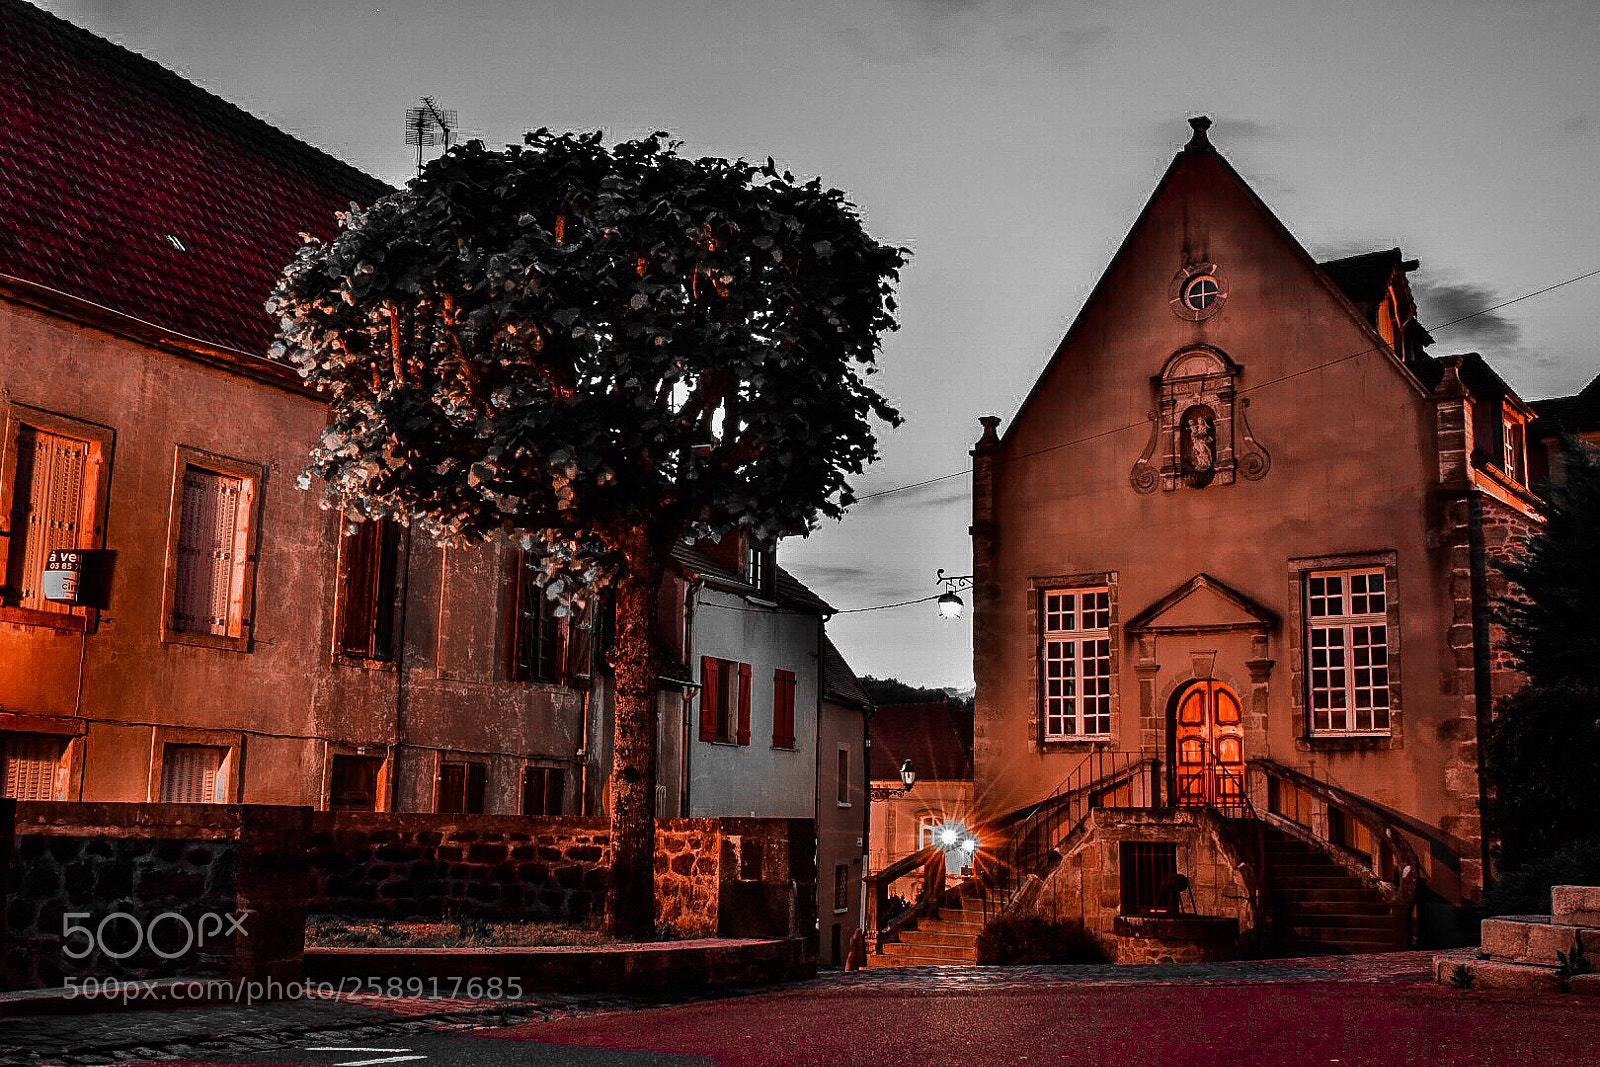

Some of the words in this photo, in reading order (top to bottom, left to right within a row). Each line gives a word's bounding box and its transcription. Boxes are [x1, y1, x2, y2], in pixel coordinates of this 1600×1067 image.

[60, 553, 79, 562] ve
[49, 562, 60, 570] 03
[61, 562, 72, 570] 85
